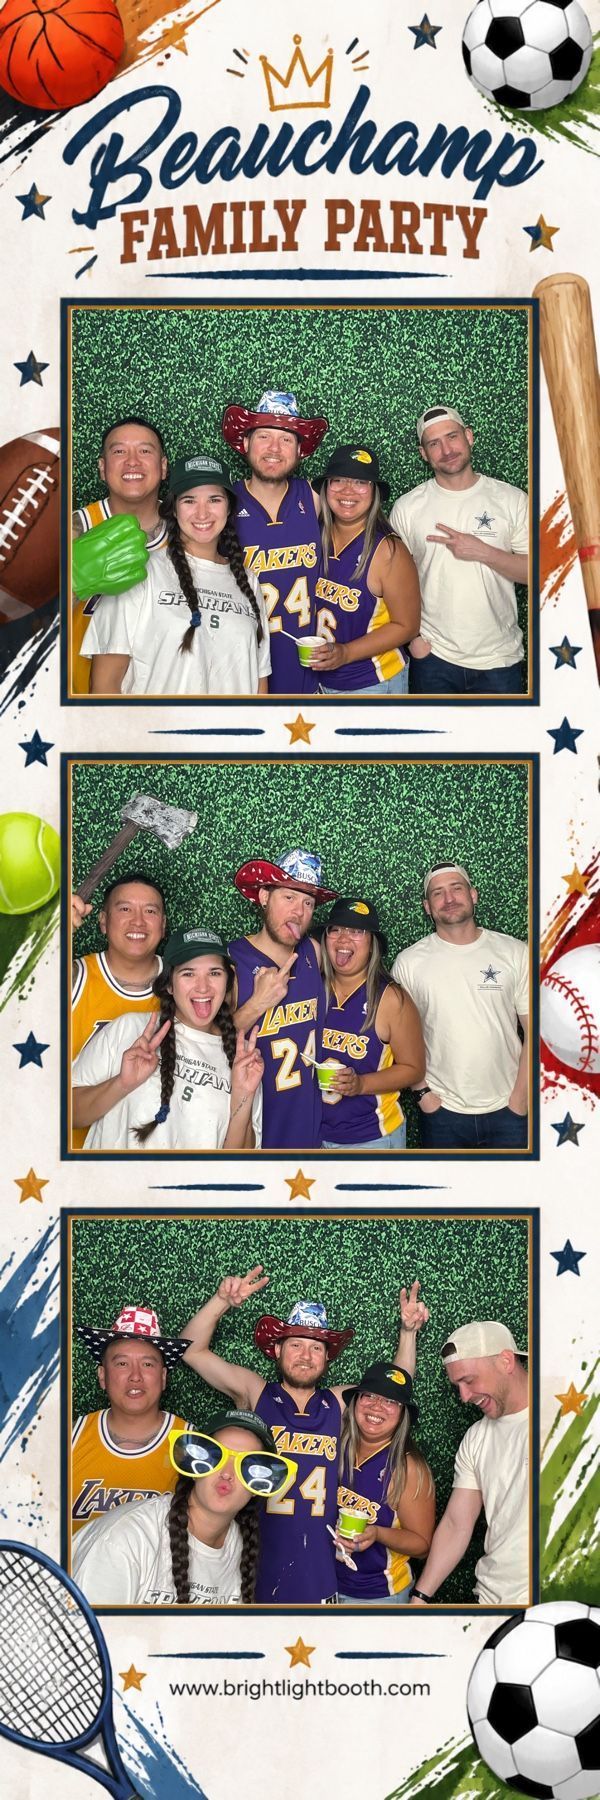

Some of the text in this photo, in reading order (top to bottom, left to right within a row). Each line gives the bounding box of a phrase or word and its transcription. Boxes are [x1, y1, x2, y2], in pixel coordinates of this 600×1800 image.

[243, 542, 317, 577] LAKERS
[218, 592, 233, 600] STATE
[259, 576, 311, 633] 24
[315, 577, 362, 612] KERS
[210, 614, 220, 629] S
[257, 998, 318, 1037] LAKER
[322, 1028, 370, 1060] KERS
[201, 1061, 217, 1073] STATE
[181, 1086, 194, 1102] S
[271, 1426, 338, 1461] LAKERS
